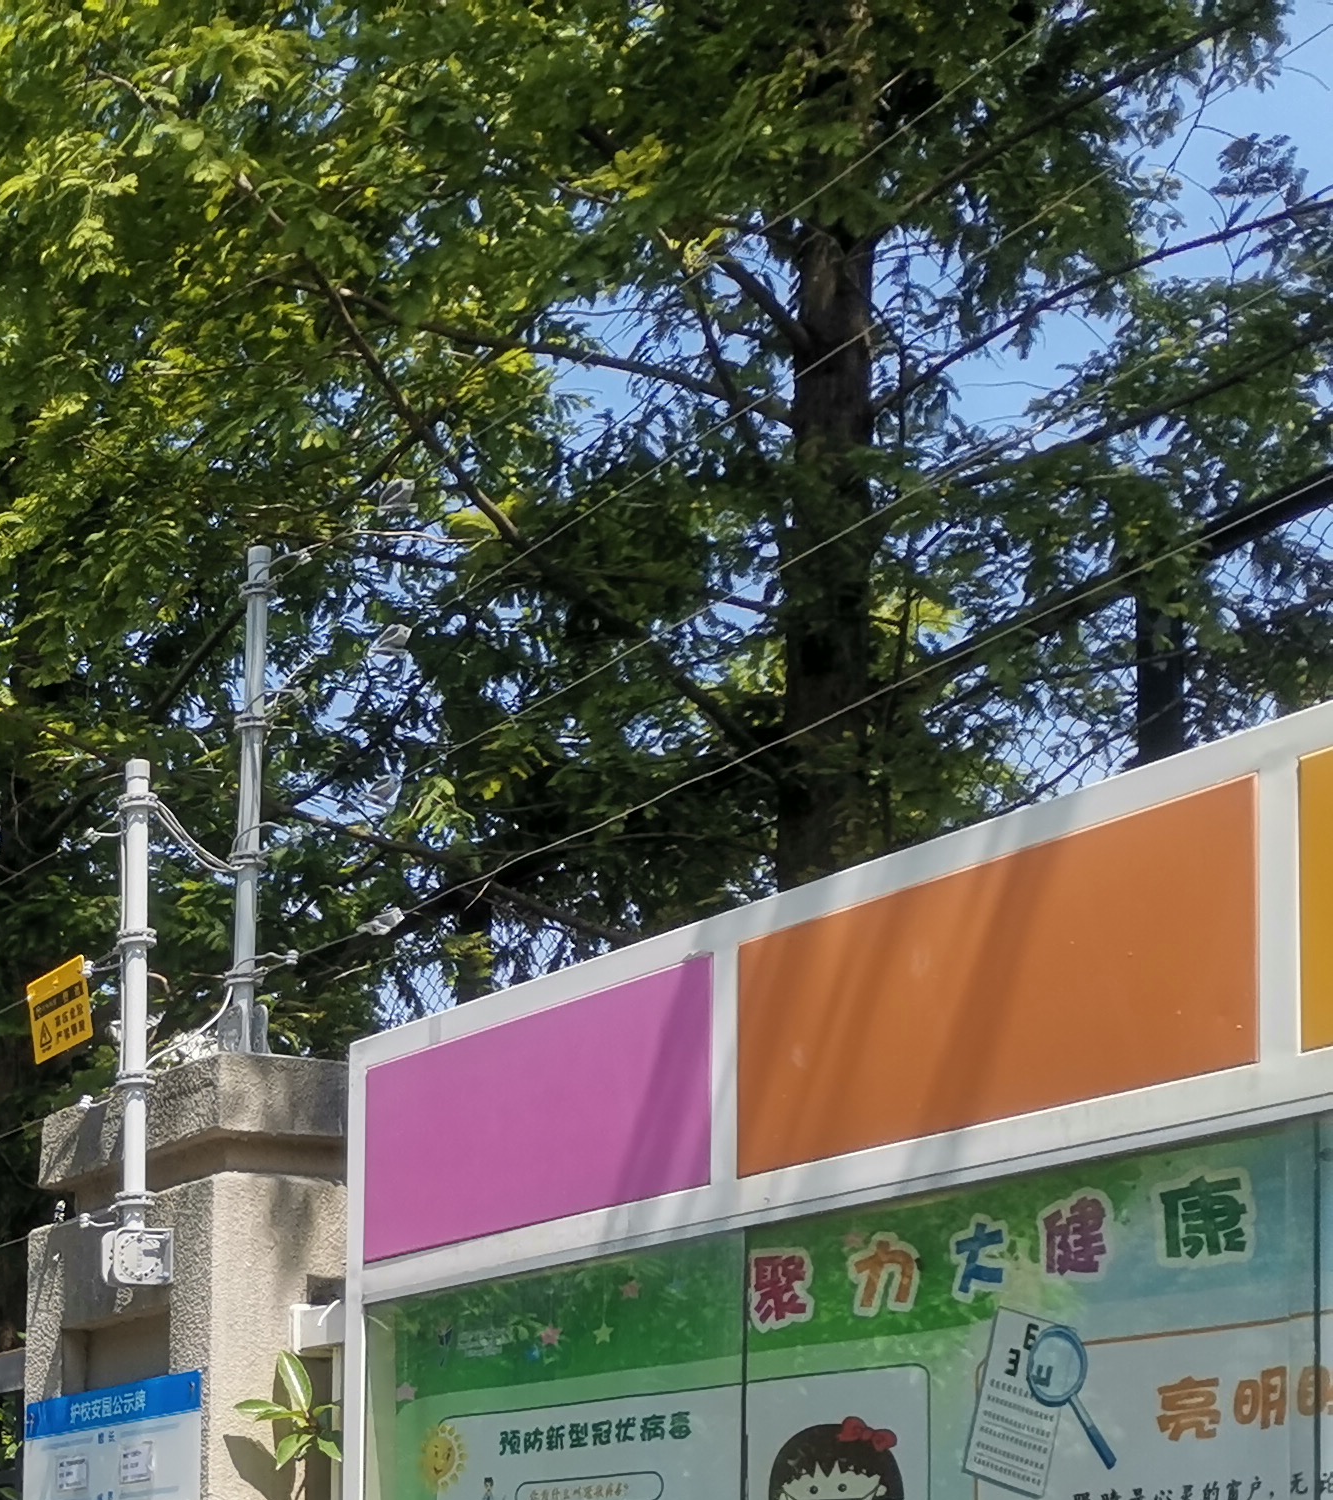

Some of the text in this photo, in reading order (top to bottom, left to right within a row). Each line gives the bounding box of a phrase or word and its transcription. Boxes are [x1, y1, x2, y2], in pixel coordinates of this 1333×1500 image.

[751, 1176, 1247, 1323] 聚力大健康
[499, 1411, 692, 1456] 预防新型冠状病毒
